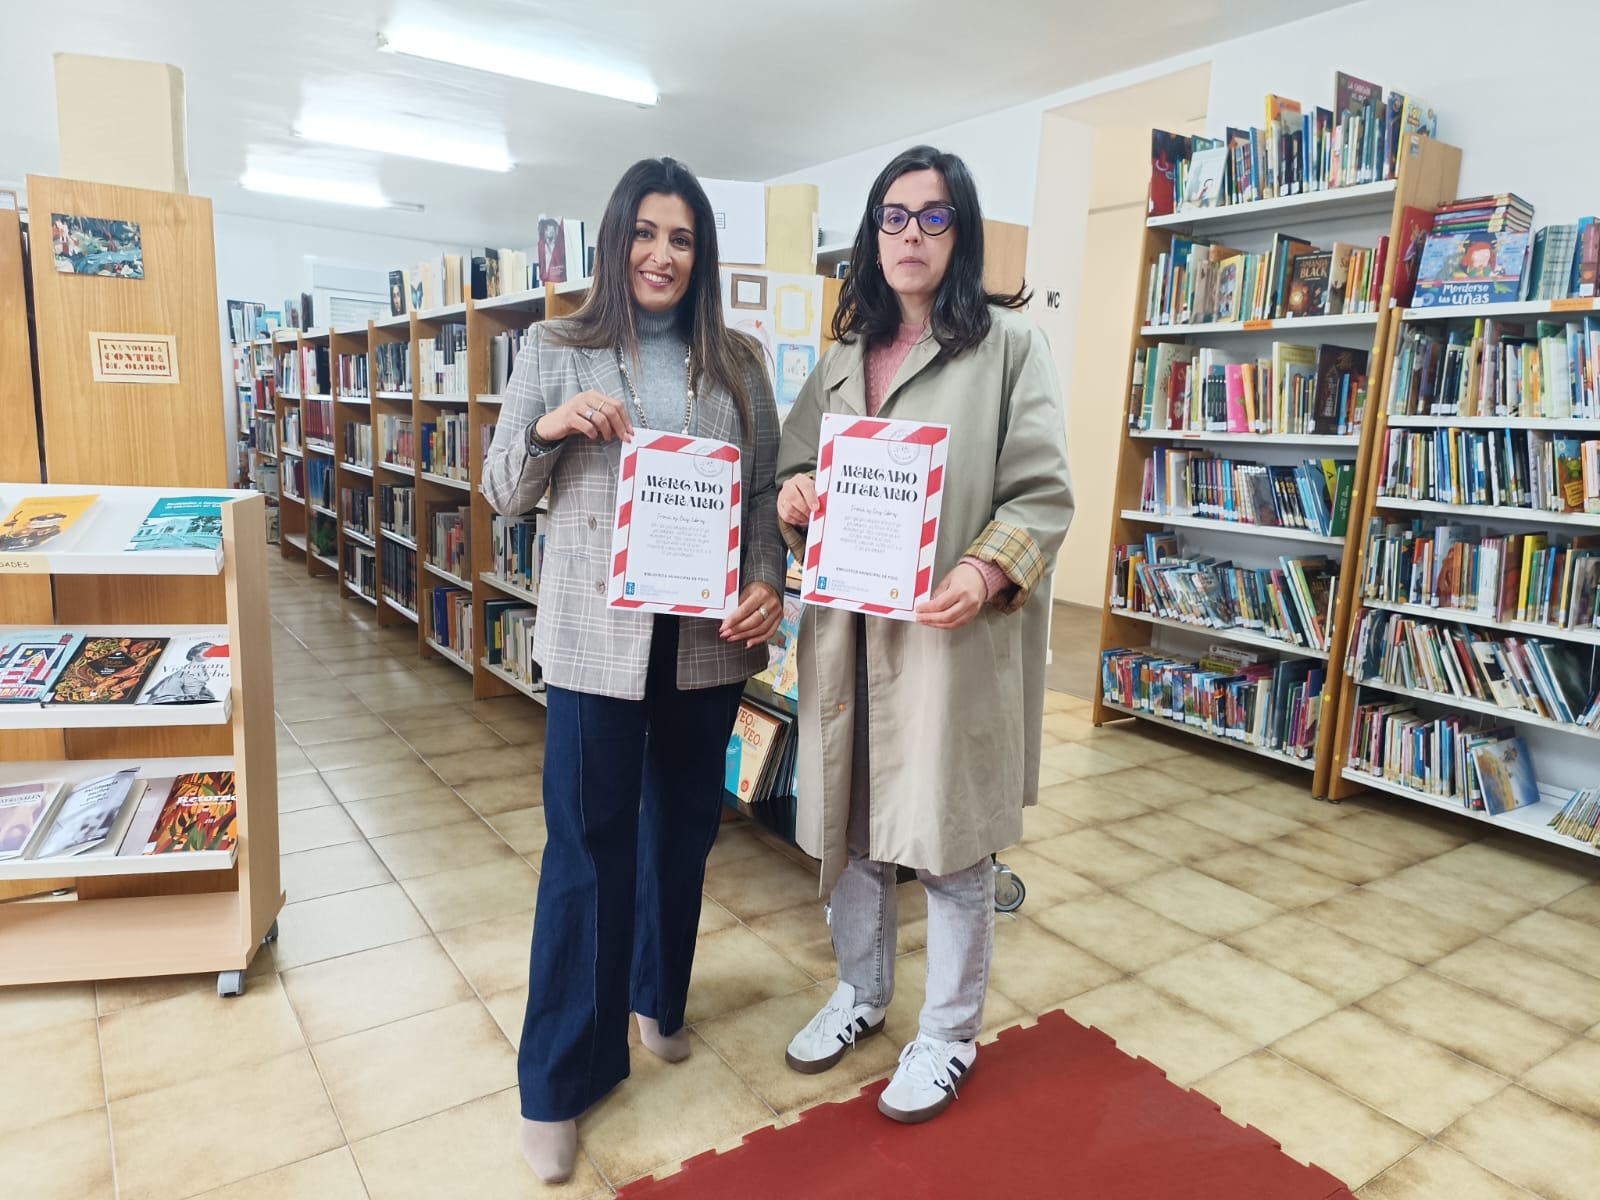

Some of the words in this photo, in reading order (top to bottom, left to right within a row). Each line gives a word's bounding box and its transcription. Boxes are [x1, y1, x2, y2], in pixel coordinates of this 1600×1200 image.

[1300, 267, 1328, 278] BLACK
[1442, 283, 1489, 295] Morderse
[1047, 290, 1060, 309] WC
[1452, 293, 1490, 305] uñas
[104, 353, 164, 362] CONTRA
[105, 362, 121, 370] EL
[125, 363, 166, 371] OLVIDO
[836, 481, 918, 503] LITERARIO
[641, 490, 725, 511] LITERARIO
